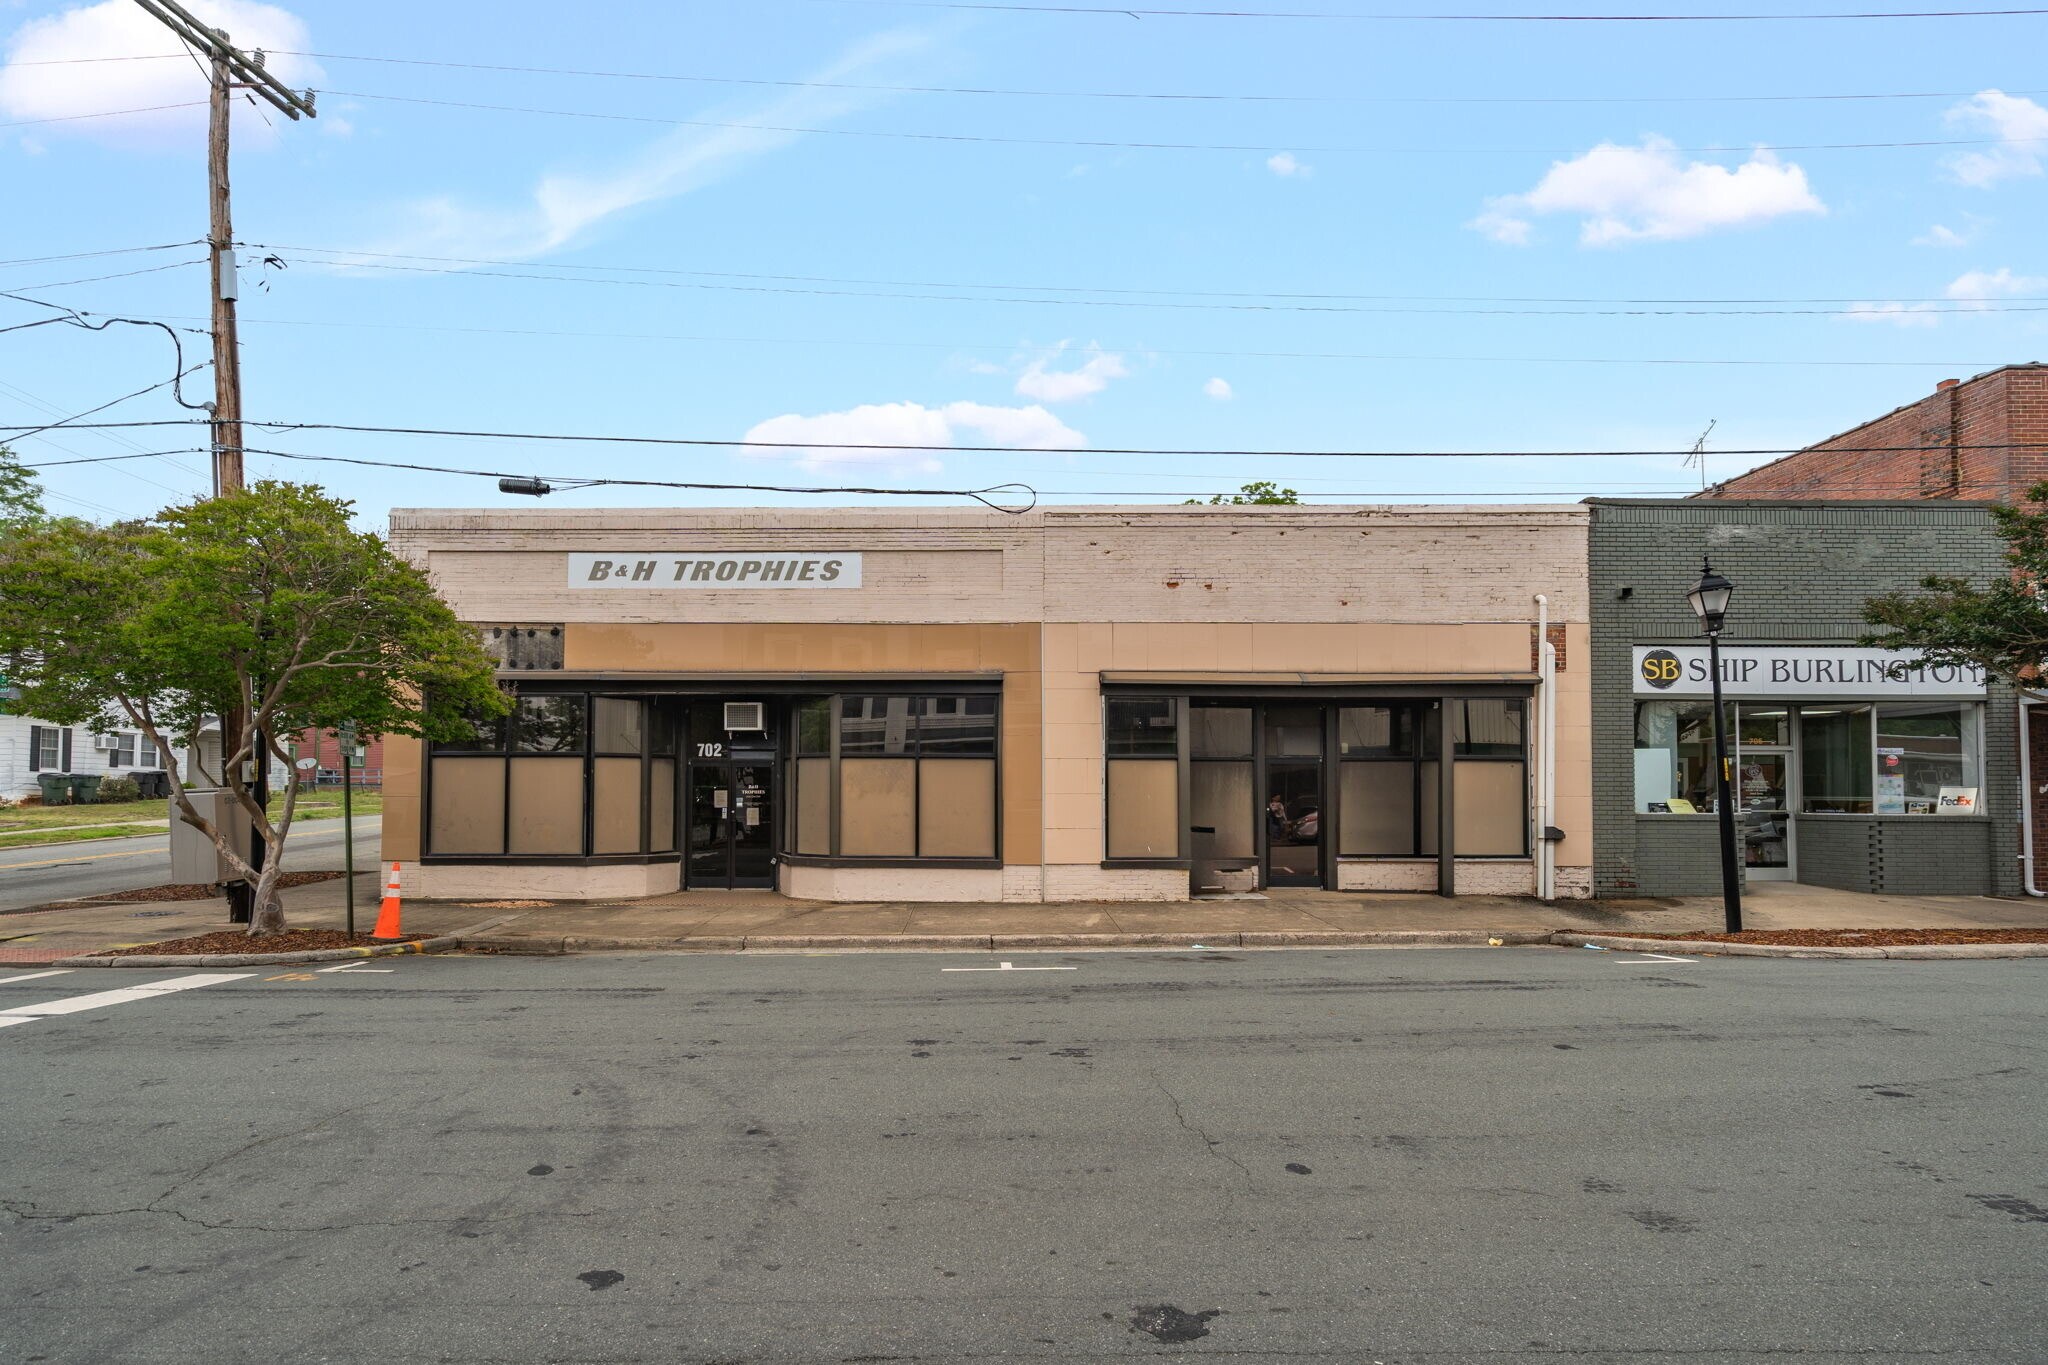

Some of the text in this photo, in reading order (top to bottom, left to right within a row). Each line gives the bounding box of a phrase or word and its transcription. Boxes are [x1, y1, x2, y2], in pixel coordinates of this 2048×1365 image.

[588, 560, 843, 581] B&H TROPHIES
[1643, 658, 1680, 680] SB
[1688, 658, 1758, 682] SHIP
[697, 743, 722, 757] 702
[1940, 795, 1972, 807] FedEx
